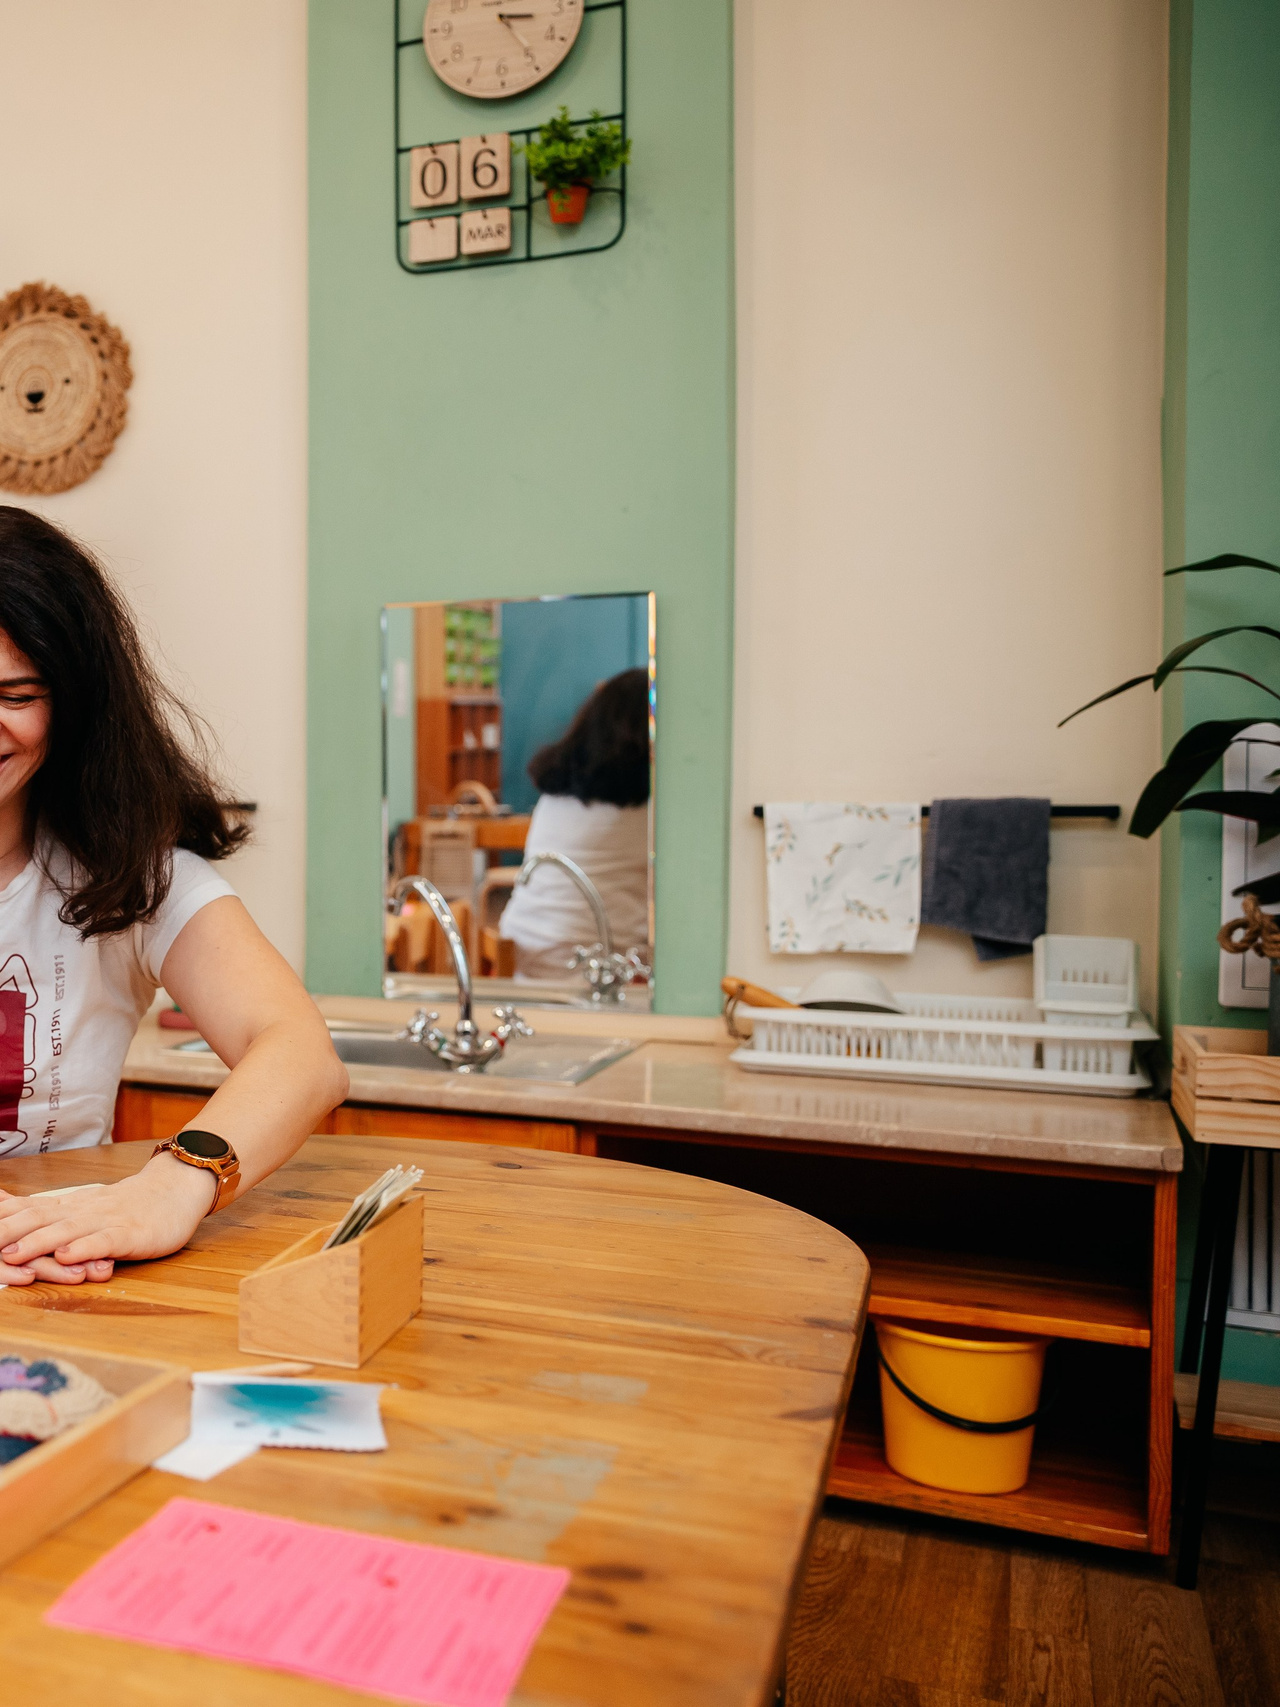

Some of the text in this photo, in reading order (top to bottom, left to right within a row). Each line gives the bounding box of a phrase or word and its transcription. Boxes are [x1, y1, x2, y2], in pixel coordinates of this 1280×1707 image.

[440, 20, 453, 40] 9
[544, 23, 556, 41] 4
[450, 42, 464, 62] 8
[523, 46, 537, 66] 5
[495, 57, 509, 78] 6
[465, 223, 507, 244] MAR
[39, 954, 66, 1154] ST.1911 EST.1911 EST.1911 EST.1911
